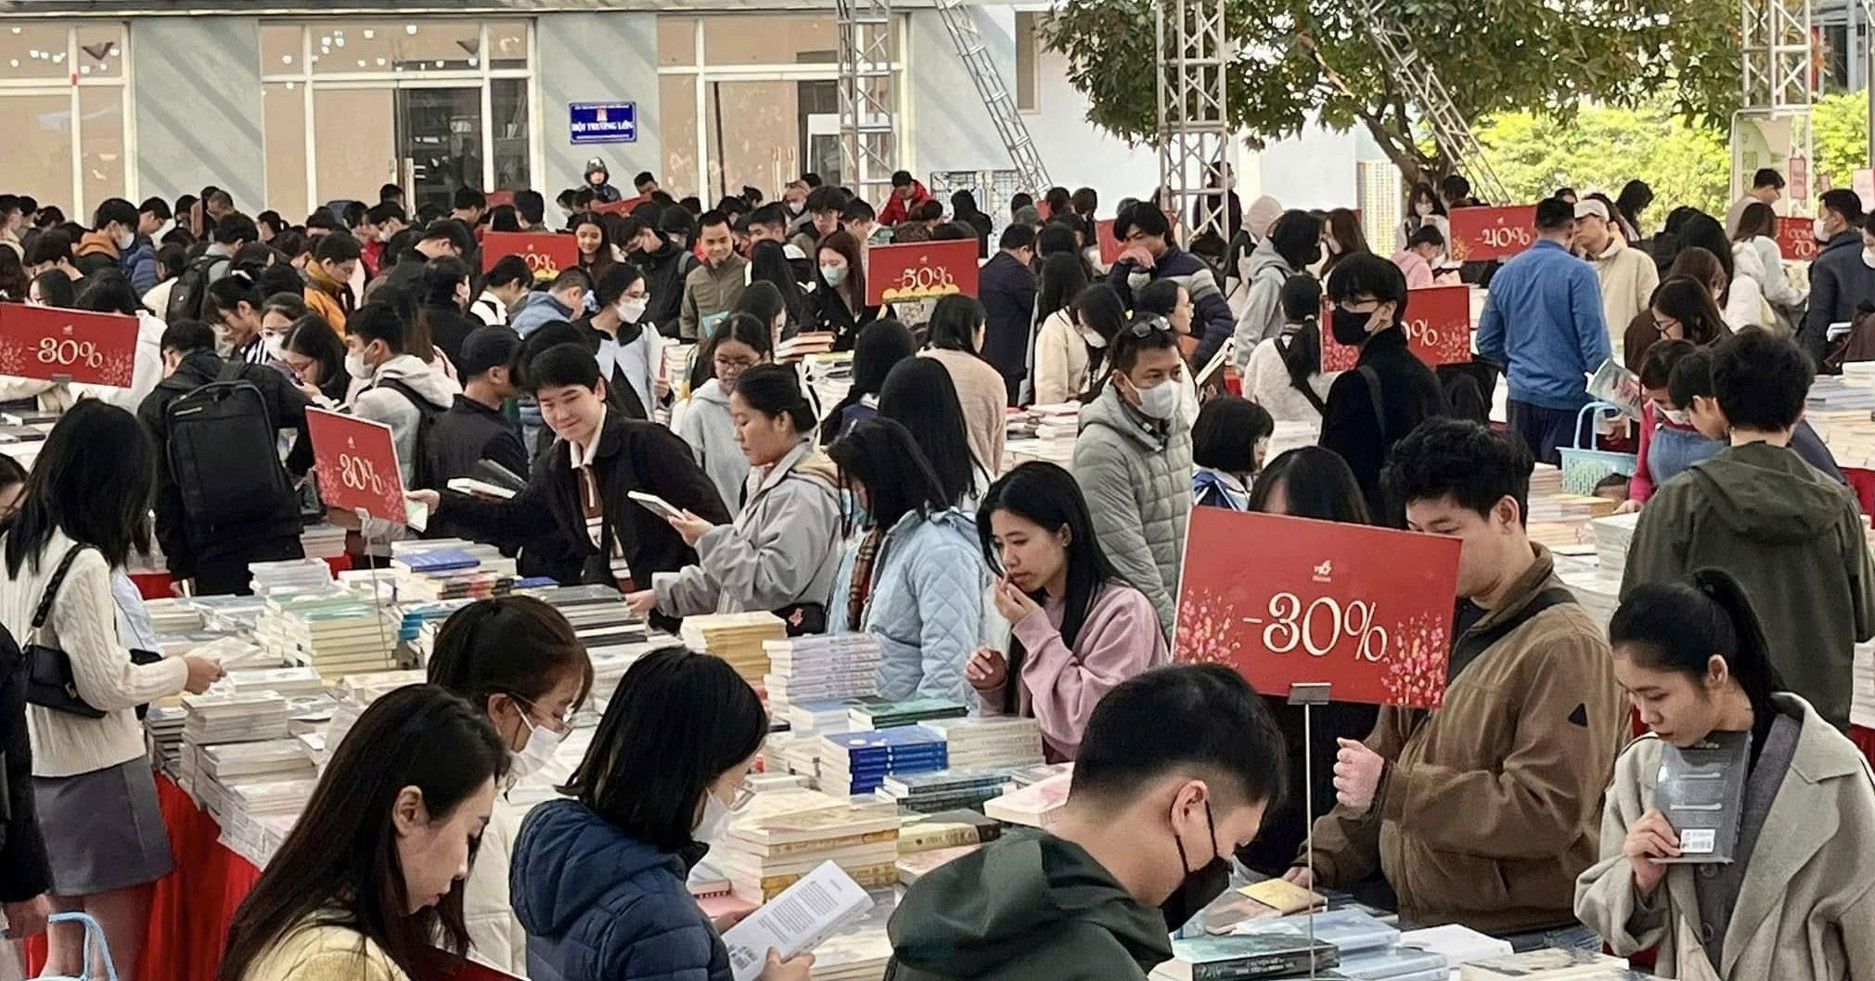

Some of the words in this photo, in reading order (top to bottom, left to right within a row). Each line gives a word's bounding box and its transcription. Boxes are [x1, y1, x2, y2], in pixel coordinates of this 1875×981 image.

[1474, 226, 1531, 248] -40%
[893, 266, 954, 290] -50%
[27, 337, 103, 368] -30%
[336, 453, 382, 495] -30%
[1243, 592, 1387, 661] -30%
